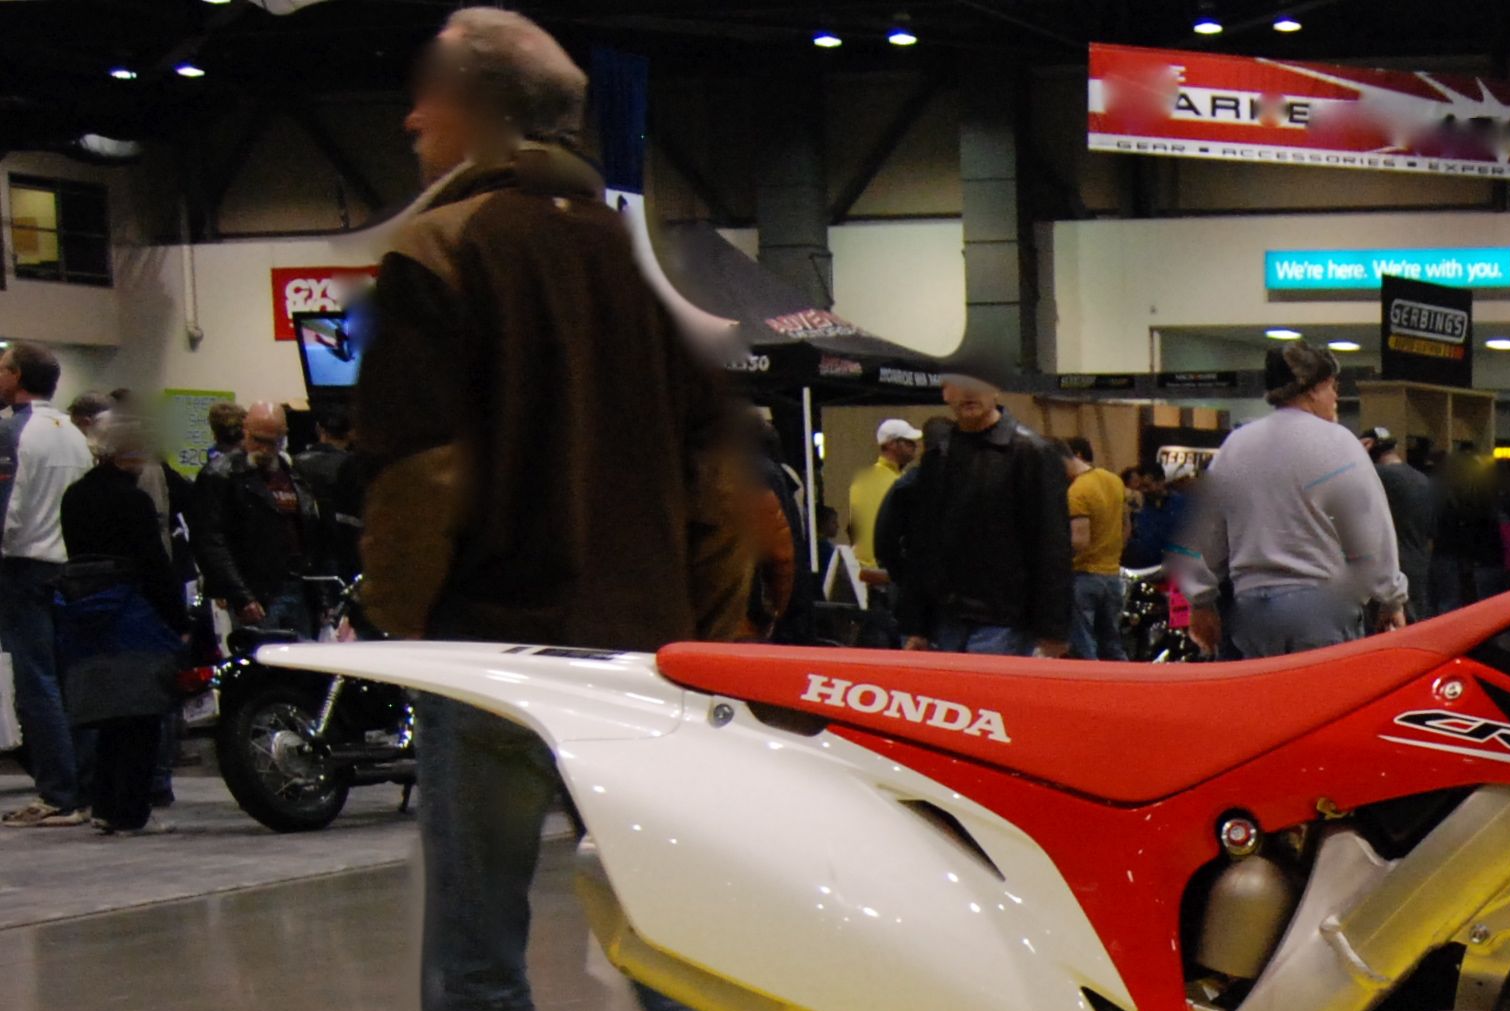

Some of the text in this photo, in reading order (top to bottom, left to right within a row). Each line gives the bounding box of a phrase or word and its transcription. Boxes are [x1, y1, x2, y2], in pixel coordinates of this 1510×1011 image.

[1116, 141, 1186, 153] GEAR
[1221, 149, 1396, 168] ACCESSORIES
[1275, 258, 1503, 282] We're here. We're with you.
[1391, 303, 1464, 335] GERBINGS
[801, 673, 1012, 743] HONDA
